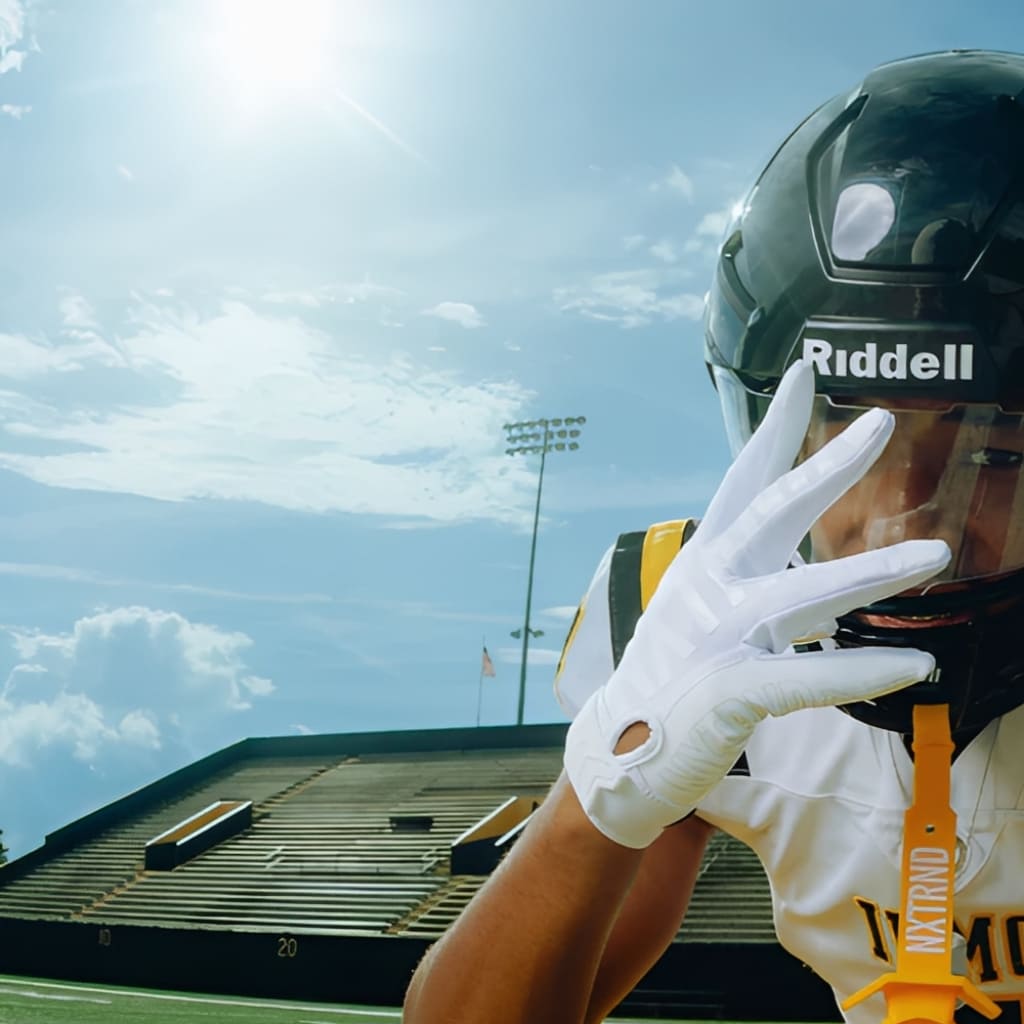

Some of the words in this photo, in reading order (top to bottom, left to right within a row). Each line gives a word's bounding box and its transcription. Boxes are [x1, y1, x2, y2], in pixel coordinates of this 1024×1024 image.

[803, 338, 973, 380] Riddell
[905, 847, 950, 954] NXTRND
[277, 937, 297, 958] 20
